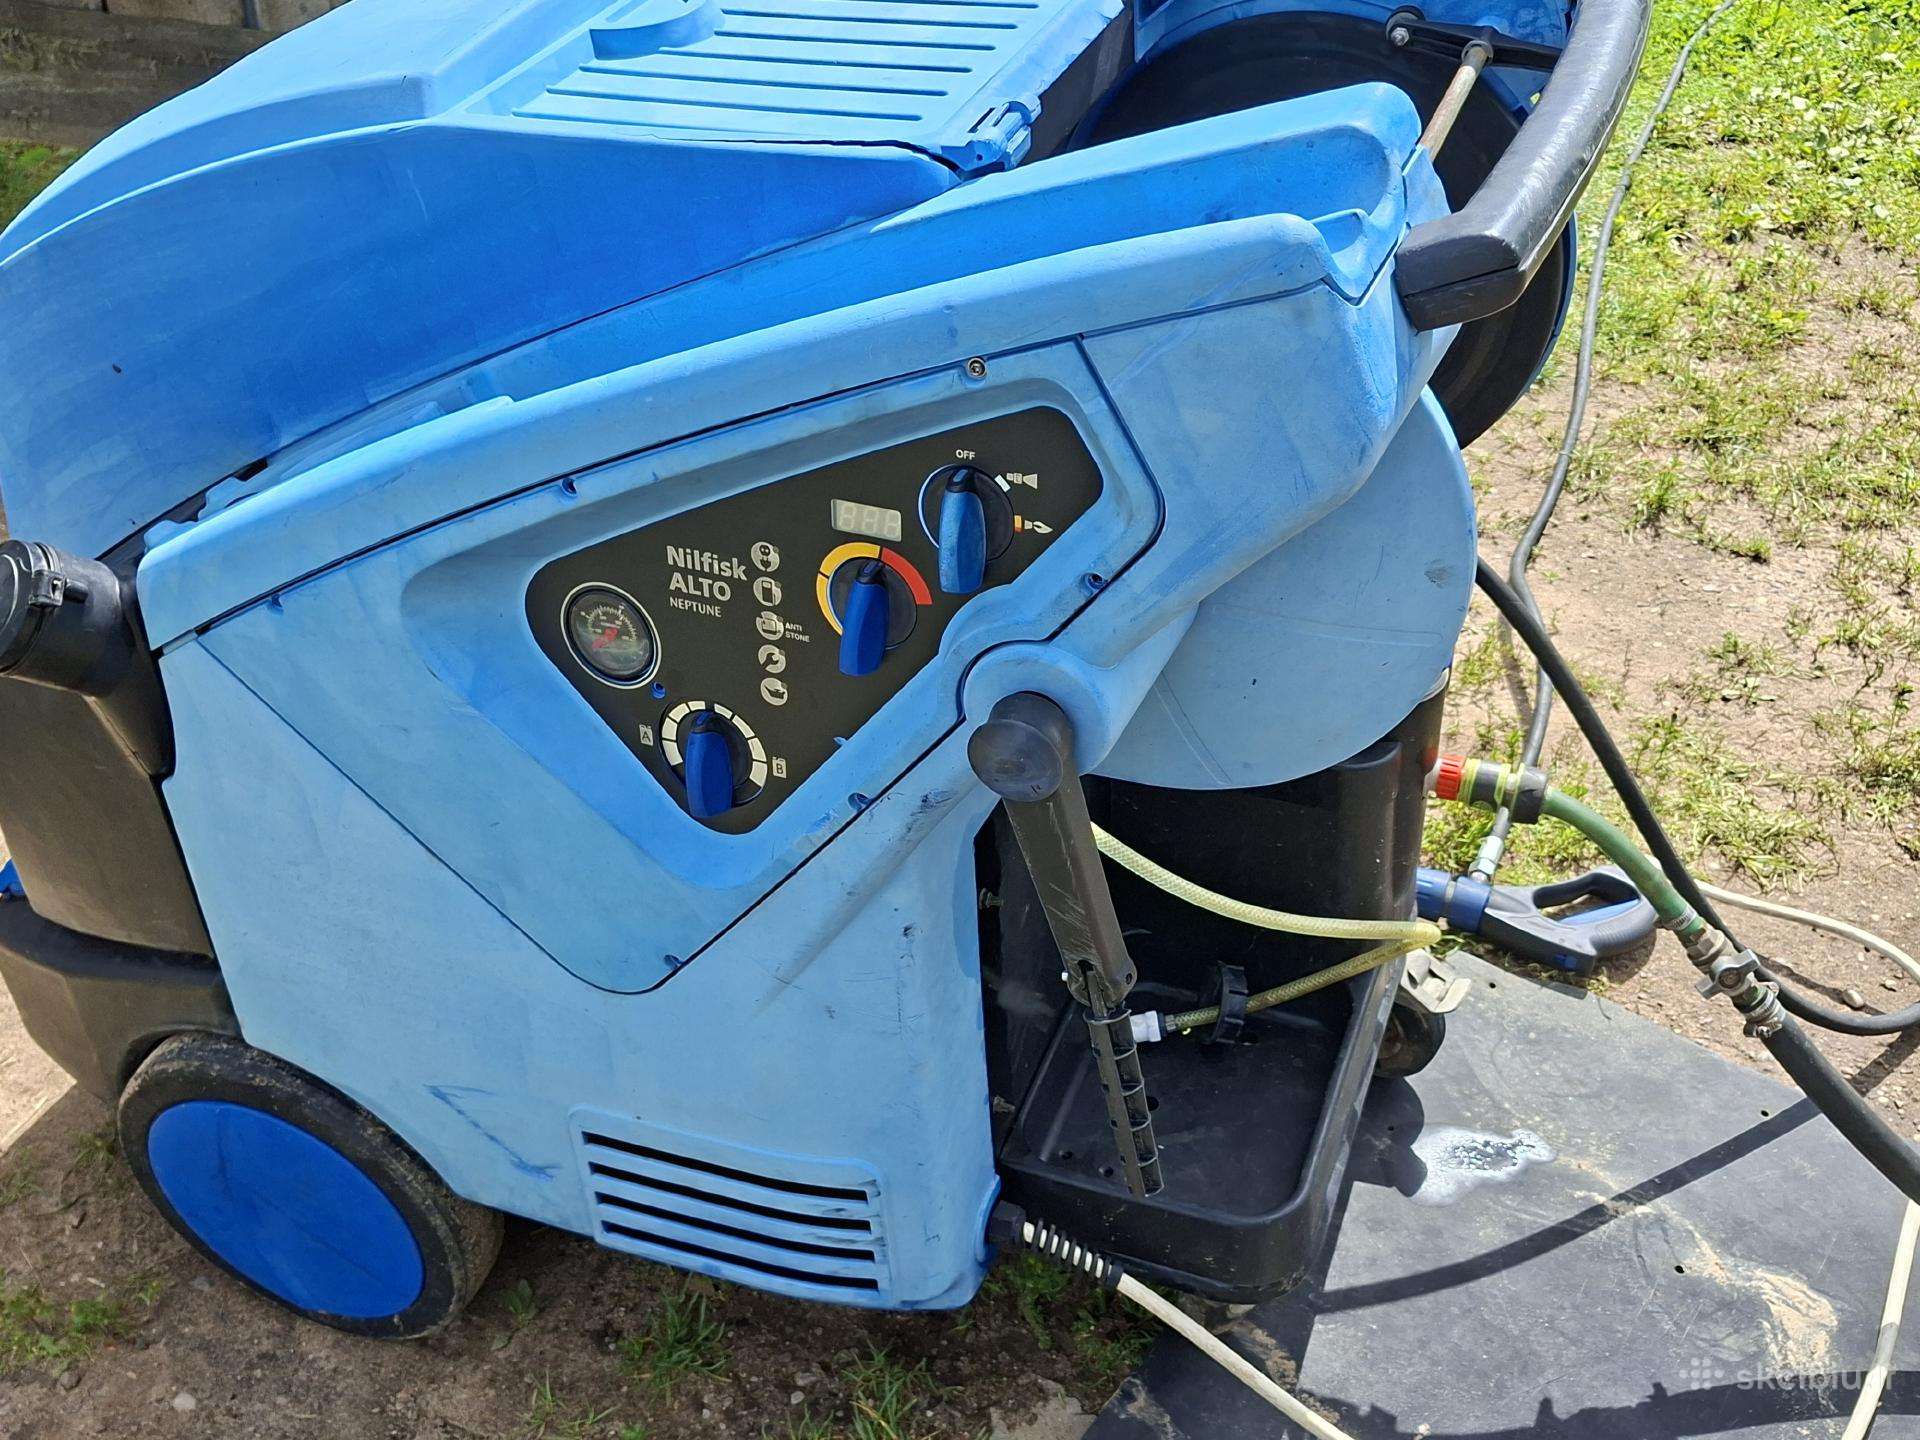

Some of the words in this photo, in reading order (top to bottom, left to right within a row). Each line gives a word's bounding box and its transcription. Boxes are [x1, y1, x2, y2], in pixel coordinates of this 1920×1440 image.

[956, 449, 976, 461] OFF
[666, 545, 748, 581] Nilfisk
[669, 572, 731, 601] ALTO
[669, 597, 722, 618] NEPTUNE
[785, 622, 803, 632] ANTI
[785, 631, 811, 642] STONE
